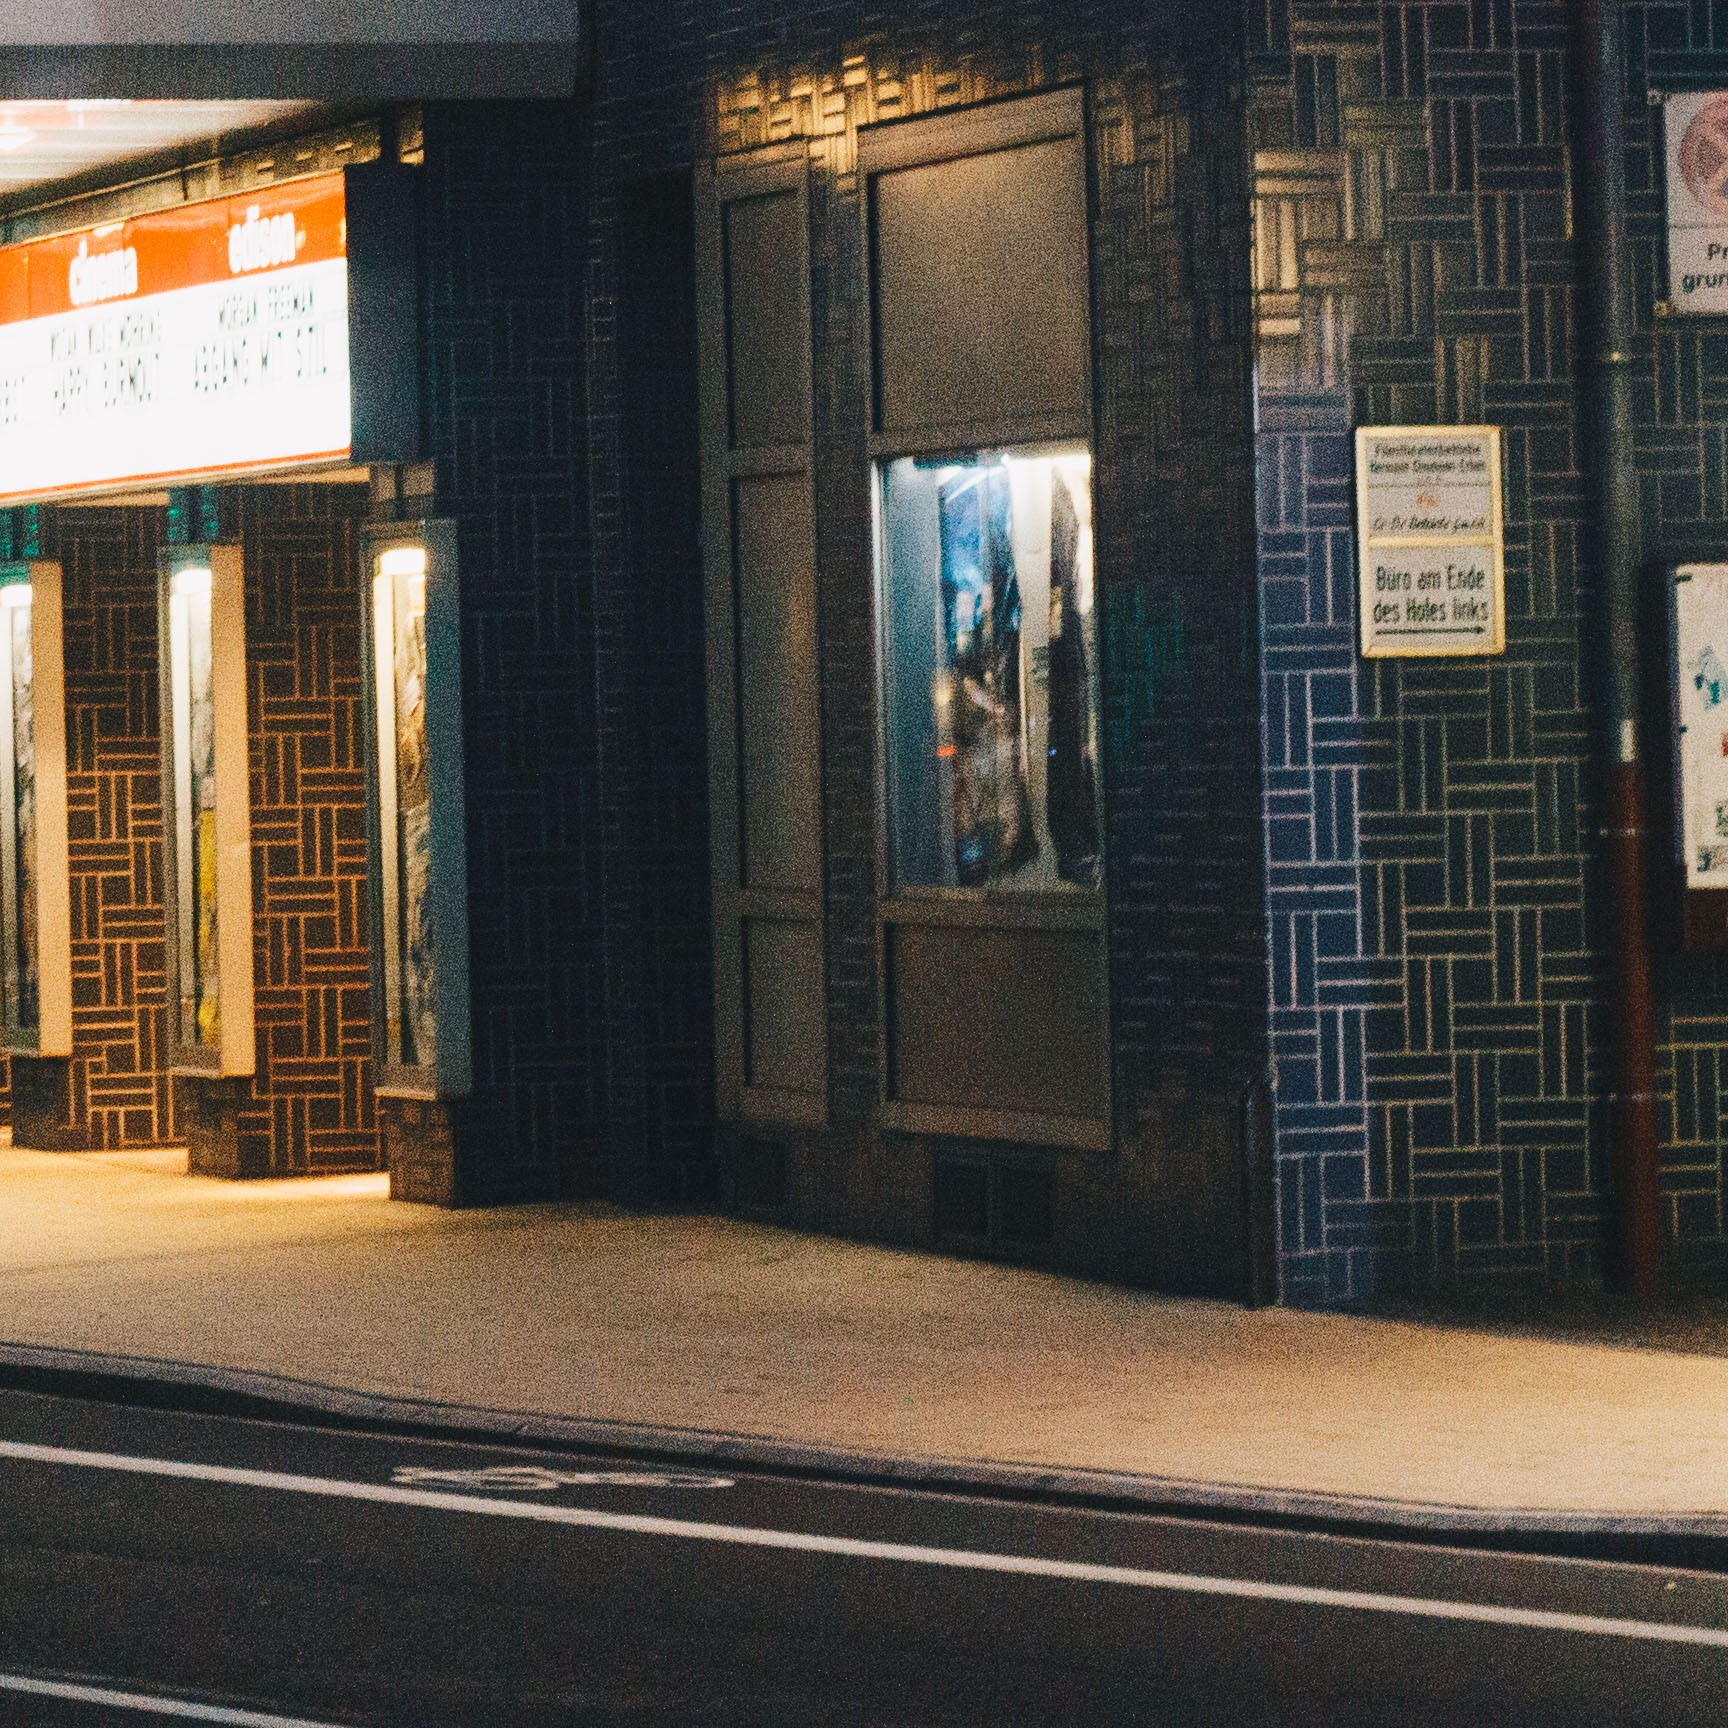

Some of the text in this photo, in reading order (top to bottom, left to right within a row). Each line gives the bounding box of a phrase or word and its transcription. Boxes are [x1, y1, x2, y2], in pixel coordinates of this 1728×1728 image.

[69, 237, 139, 306] cinema
[228, 204, 296, 274] edison
[1417, 571, 1441, 590] am
[1446, 563, 1485, 591] Ende
